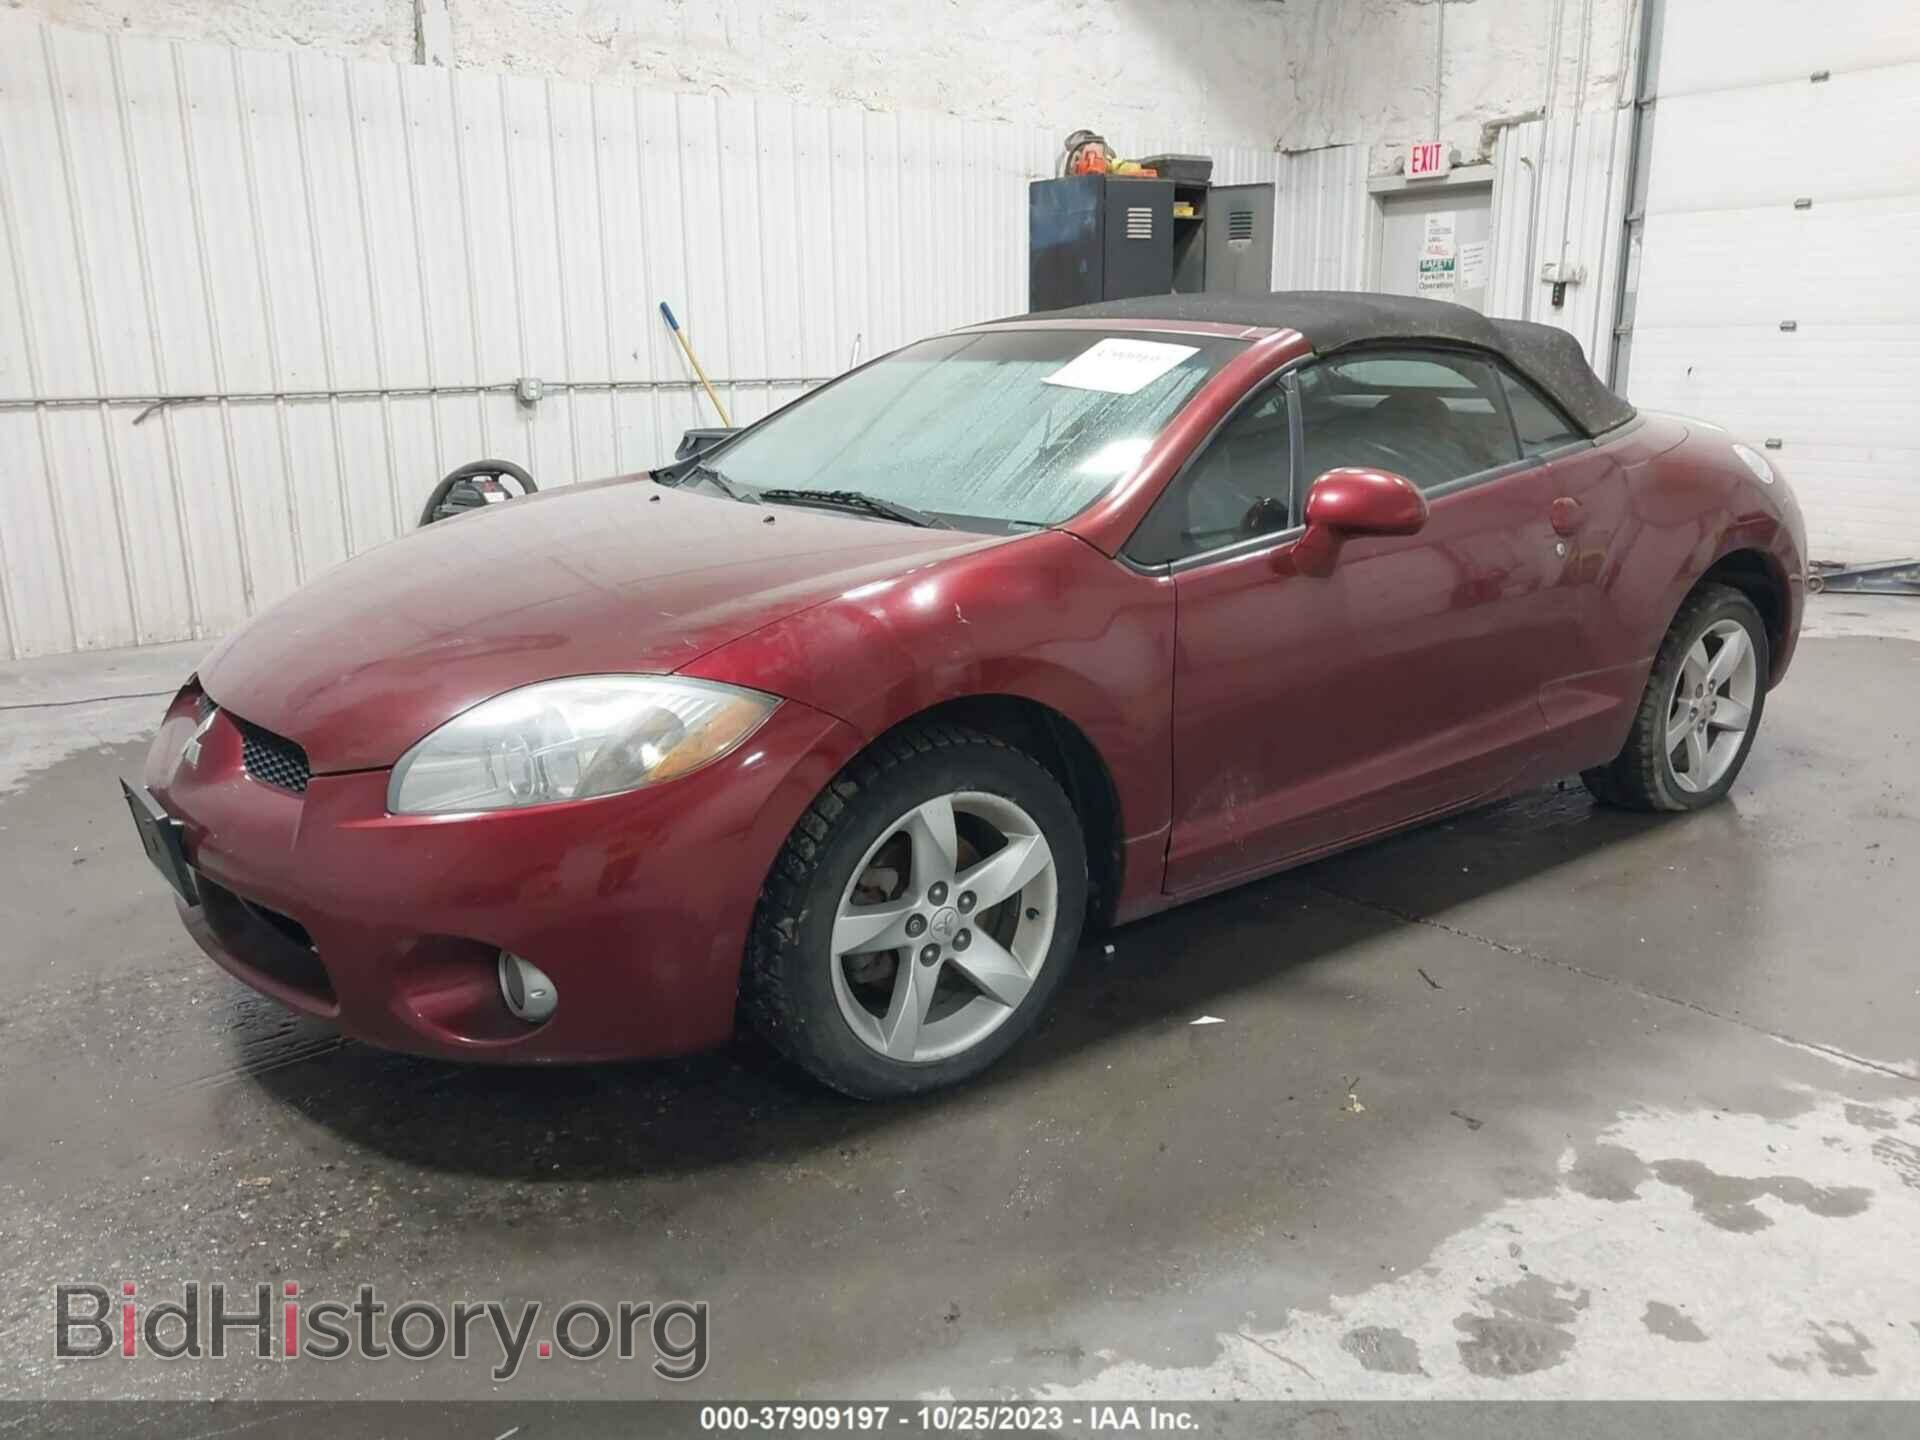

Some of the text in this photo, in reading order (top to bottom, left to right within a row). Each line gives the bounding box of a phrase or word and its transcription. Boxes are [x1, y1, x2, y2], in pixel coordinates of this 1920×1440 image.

[1412, 143, 1442, 173] EXIT
[1420, 272, 1445, 281] Forklift
[1419, 281, 1454, 290] Operation
